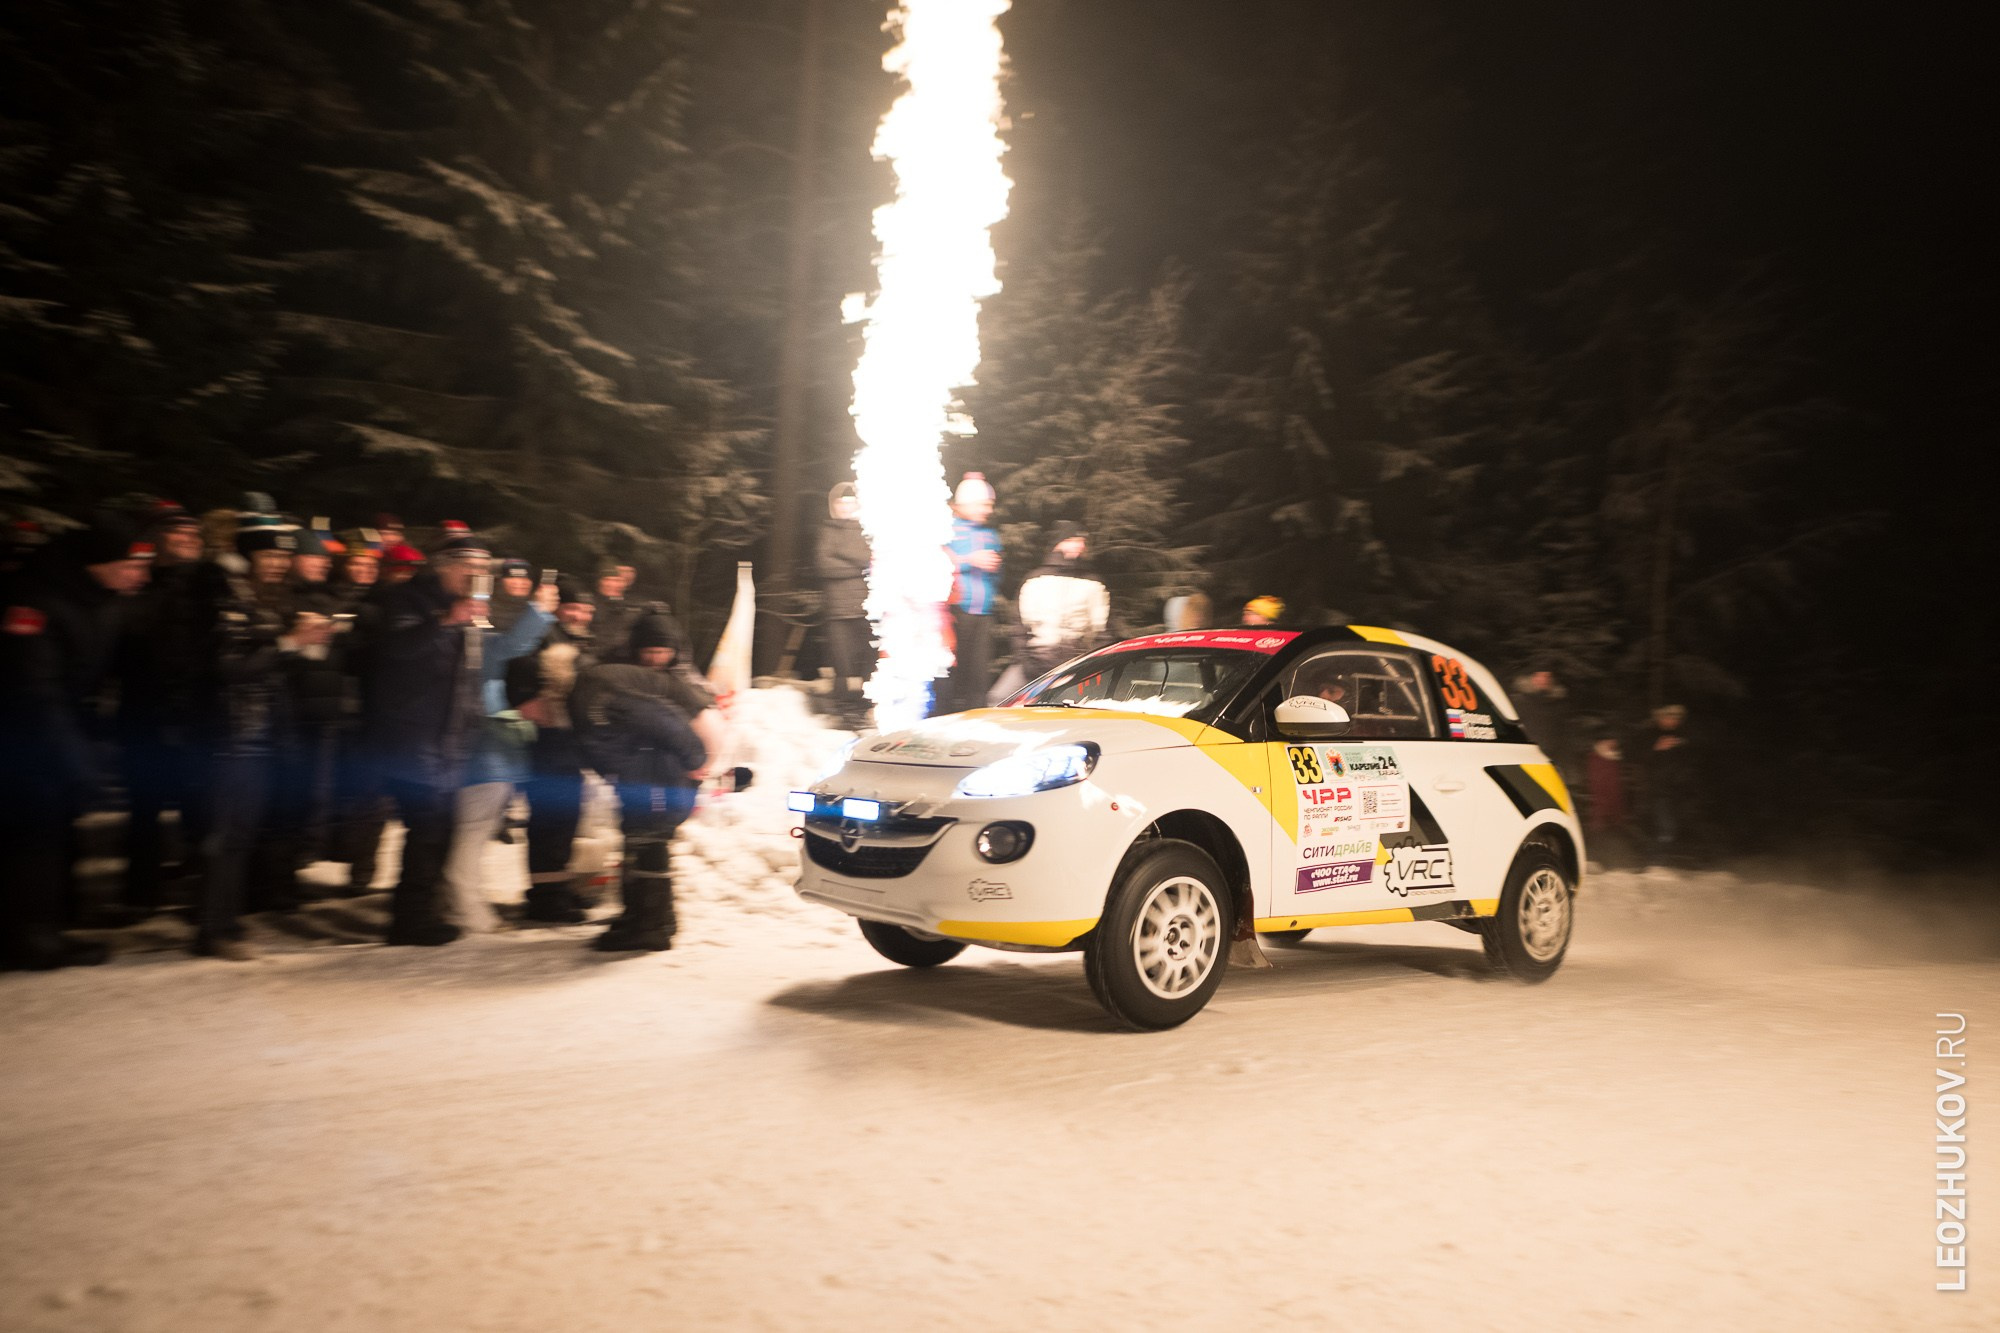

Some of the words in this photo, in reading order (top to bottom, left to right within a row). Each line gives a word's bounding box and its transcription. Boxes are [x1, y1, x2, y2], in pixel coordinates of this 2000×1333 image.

[1431, 655, 1478, 711] 33
[1288, 747, 1323, 784] 33
[1302, 787, 1352, 805] ЧРР
[1303, 806, 1333, 814] ЧЕМПИОНАТ
[1303, 840, 1372, 859] СИТИДРАЙВ
[1397, 858, 1445, 880] VRC
[1312, 874, 1358, 888] www.staf.ru
[974, 887, 1005, 896] VRC
